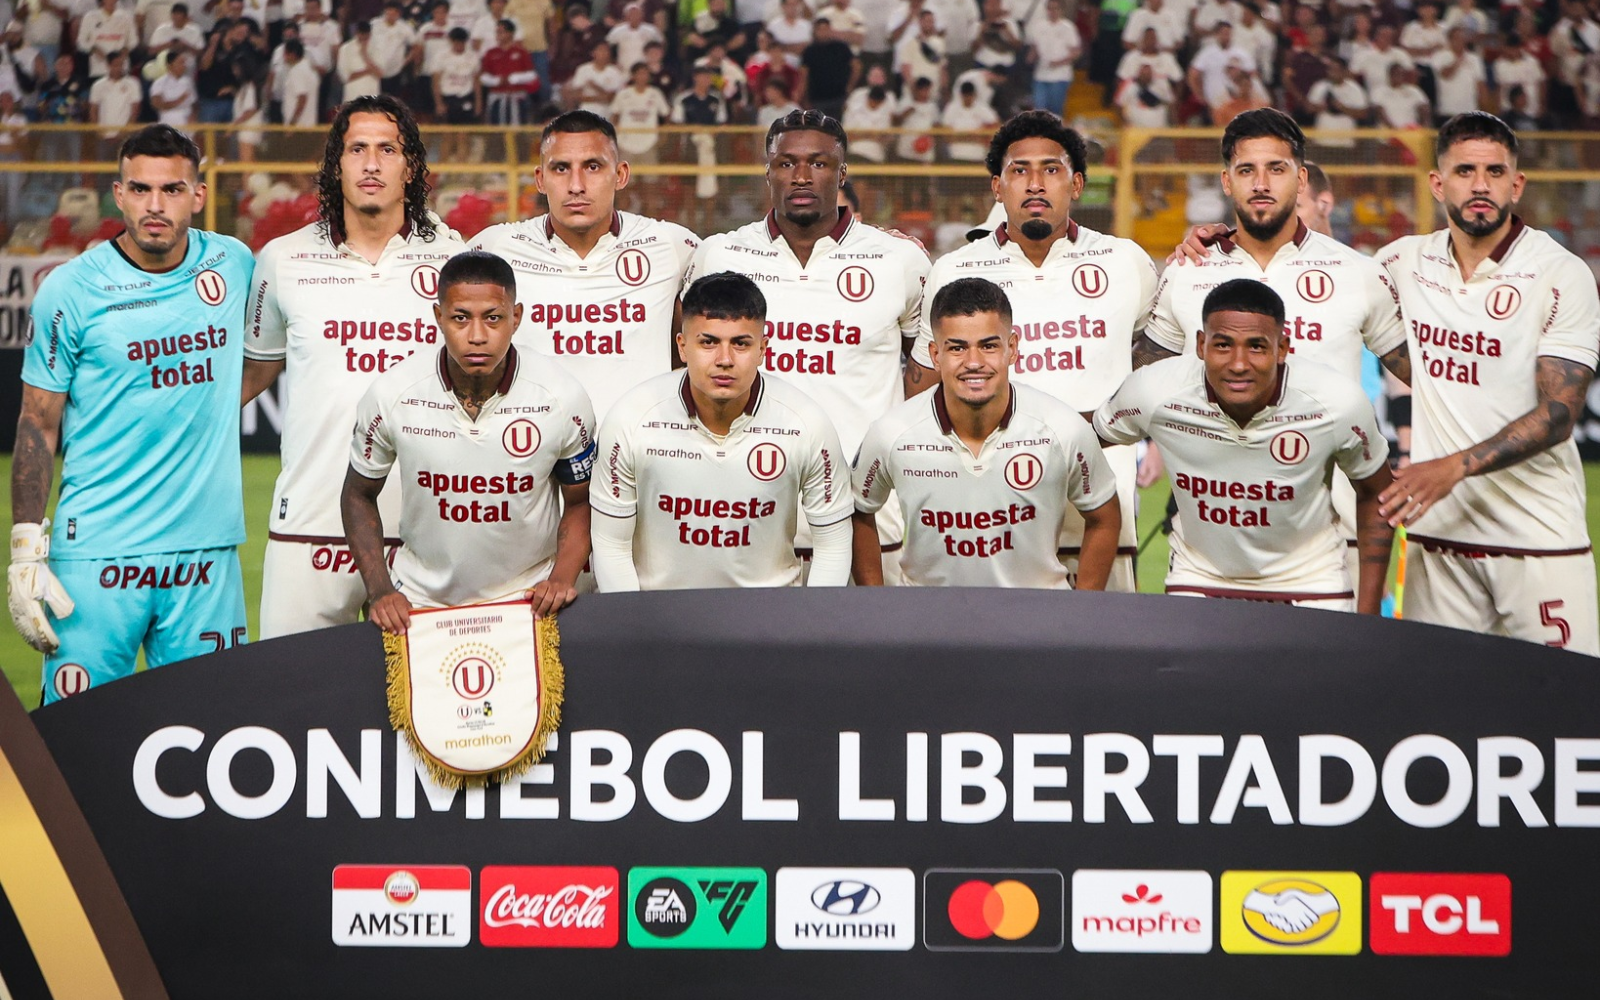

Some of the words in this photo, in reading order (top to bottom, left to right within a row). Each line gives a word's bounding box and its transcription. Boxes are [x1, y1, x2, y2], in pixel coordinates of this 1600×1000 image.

[290, 252, 349, 260] JETOUR
[511, 233, 557, 253] JETR
[608, 236, 657, 252] ETOUR
[724, 244, 779, 258] JETOUR
[1062, 248, 1113, 259] JETOUR
[184, 251, 226, 277] JETOUR
[510, 259, 563, 273] marathon
[622, 255, 643, 282] U
[955, 257, 1011, 268] JETOUR
[200, 274, 222, 302] U
[297, 275, 356, 286] marathon
[417, 271, 438, 296] U
[846, 272, 866, 298] U
[1080, 270, 1101, 294] U
[1305, 276, 1325, 299] U
[106, 299, 158, 313] marathon
[254, 280, 269, 328] MOVISUN
[531, 298, 646, 330] apuesta
[1493, 290, 1515, 316] U
[323, 317, 438, 347] apuesta
[763, 319, 862, 346] uesta
[1012, 314, 1107, 340] uesta
[1411, 319, 1502, 358] apuesta
[126, 324, 228, 366] apuesta
[553, 330, 625, 355] total
[345, 346, 415, 374] tot
[764, 348, 837, 375] total
[1014, 345, 1086, 374] total
[1422, 351, 1480, 387] total
[151, 357, 215, 390] total
[400, 398, 456, 411] JETOUR
[494, 404, 551, 415] JETOUR
[1163, 403, 1220, 419] JETOUR
[364, 414, 383, 446] MVUN
[642, 421, 699, 431] JETOUR
[1264, 412, 1324, 424] JETOUR
[402, 425, 456, 439] marathon
[511, 426, 532, 453] U
[742, 426, 801, 437] JETOUR
[996, 438, 1051, 450] JETOUR
[1165, 421, 1223, 442] marathon
[646, 448, 702, 461] marathon
[896, 444, 954, 453] JETOUR
[1279, 436, 1301, 462] U
[756, 450, 778, 477] U
[862, 458, 881, 489] MOVISUN
[903, 468, 958, 479] marathon
[1013, 460, 1034, 486] U
[417, 471, 535, 497] apuesta
[823, 460, 832, 504] MOVISUN
[1176, 472, 1295, 502] apuesta
[437, 498, 512, 524] total
[657, 494, 776, 521] apuesta
[920, 503, 1036, 534] apuesta
[1197, 499, 1271, 528] total
[678, 521, 751, 548] total
[943, 531, 1014, 558] total
[99, 560, 215, 590] OPALUX
[435, 619, 453, 630] CLUB
[454, 614, 503, 627] UNIVERSITARIO
[448, 628, 457, 637] DE
[458, 624, 492, 636] DEPORTES
[461, 665, 485, 695] U
[444, 733, 513, 750] marathon
[132, 725, 800, 822] CONMEBOL
[838, 730, 1600, 828] LIBERTADORE
[484, 883, 614, 929] Coca-Cola
[646, 888, 687, 911] EA
[348, 912, 455, 937] AMSTEL
[644, 909, 688, 923] SPORTS
[1083, 912, 1203, 938] mapfre
[1381, 894, 1500, 935] TCL
[794, 922, 896, 940] HYUNDAI
